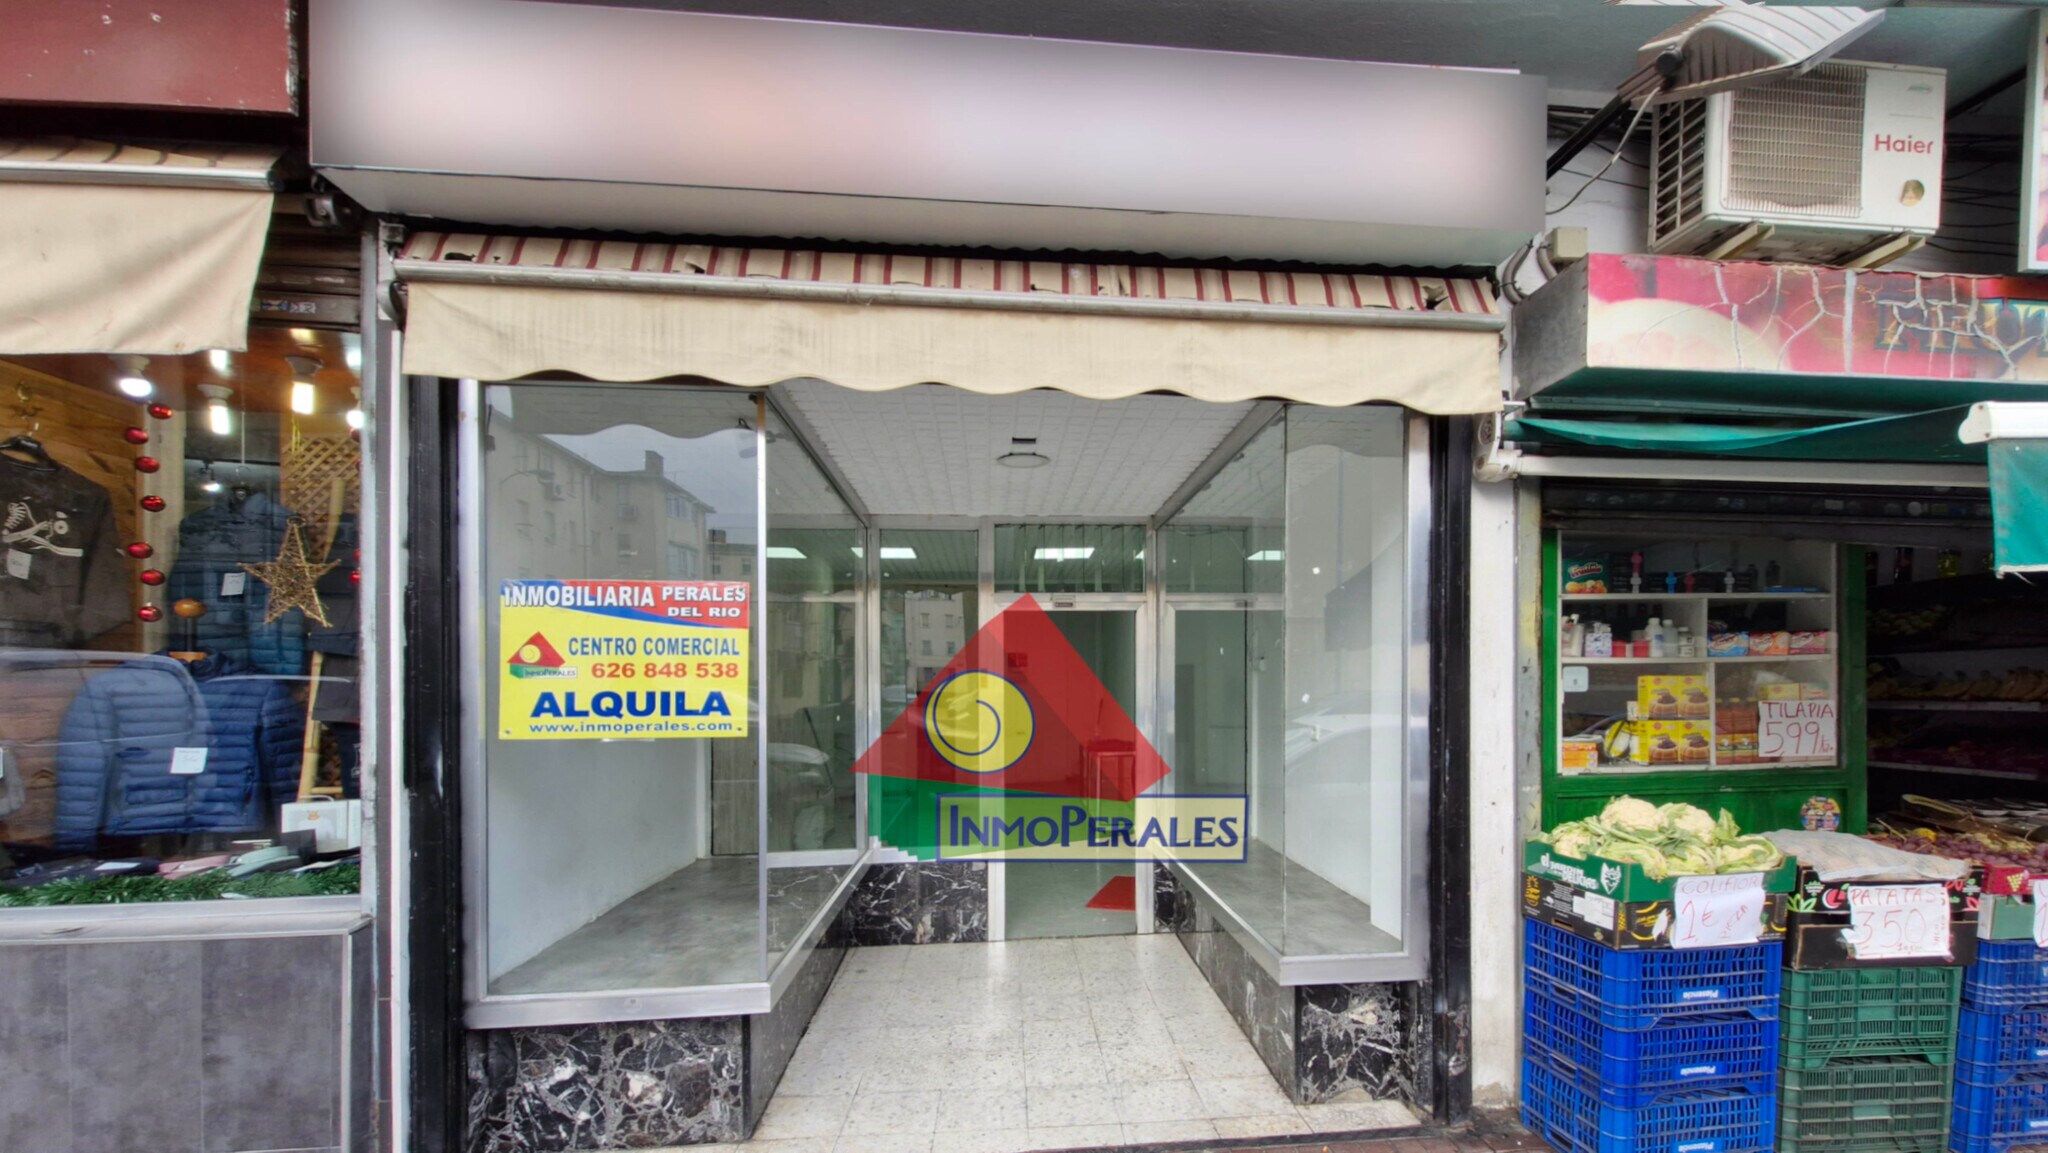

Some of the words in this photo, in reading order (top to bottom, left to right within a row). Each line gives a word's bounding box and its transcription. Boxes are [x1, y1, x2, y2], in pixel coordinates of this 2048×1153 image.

[1875, 133, 1934, 154] Haier
[504, 585, 655, 607] INMOBILIARIA
[661, 586, 746, 602] PERALES
[667, 606, 702, 617] DEL
[709, 606, 741, 617] RIO
[568, 637, 636, 656] CENTRO
[643, 637, 740, 656] COMERCIAL
[591, 662, 636, 678] 626
[643, 662, 688, 678] 848
[695, 662, 739, 678] 538
[530, 690, 731, 719] ALQUILA
[1761, 702, 1834, 719] TILAPIA
[529, 721, 732, 734] www.inmoperales.com
[1850, 886, 1937, 906] PATATAS
